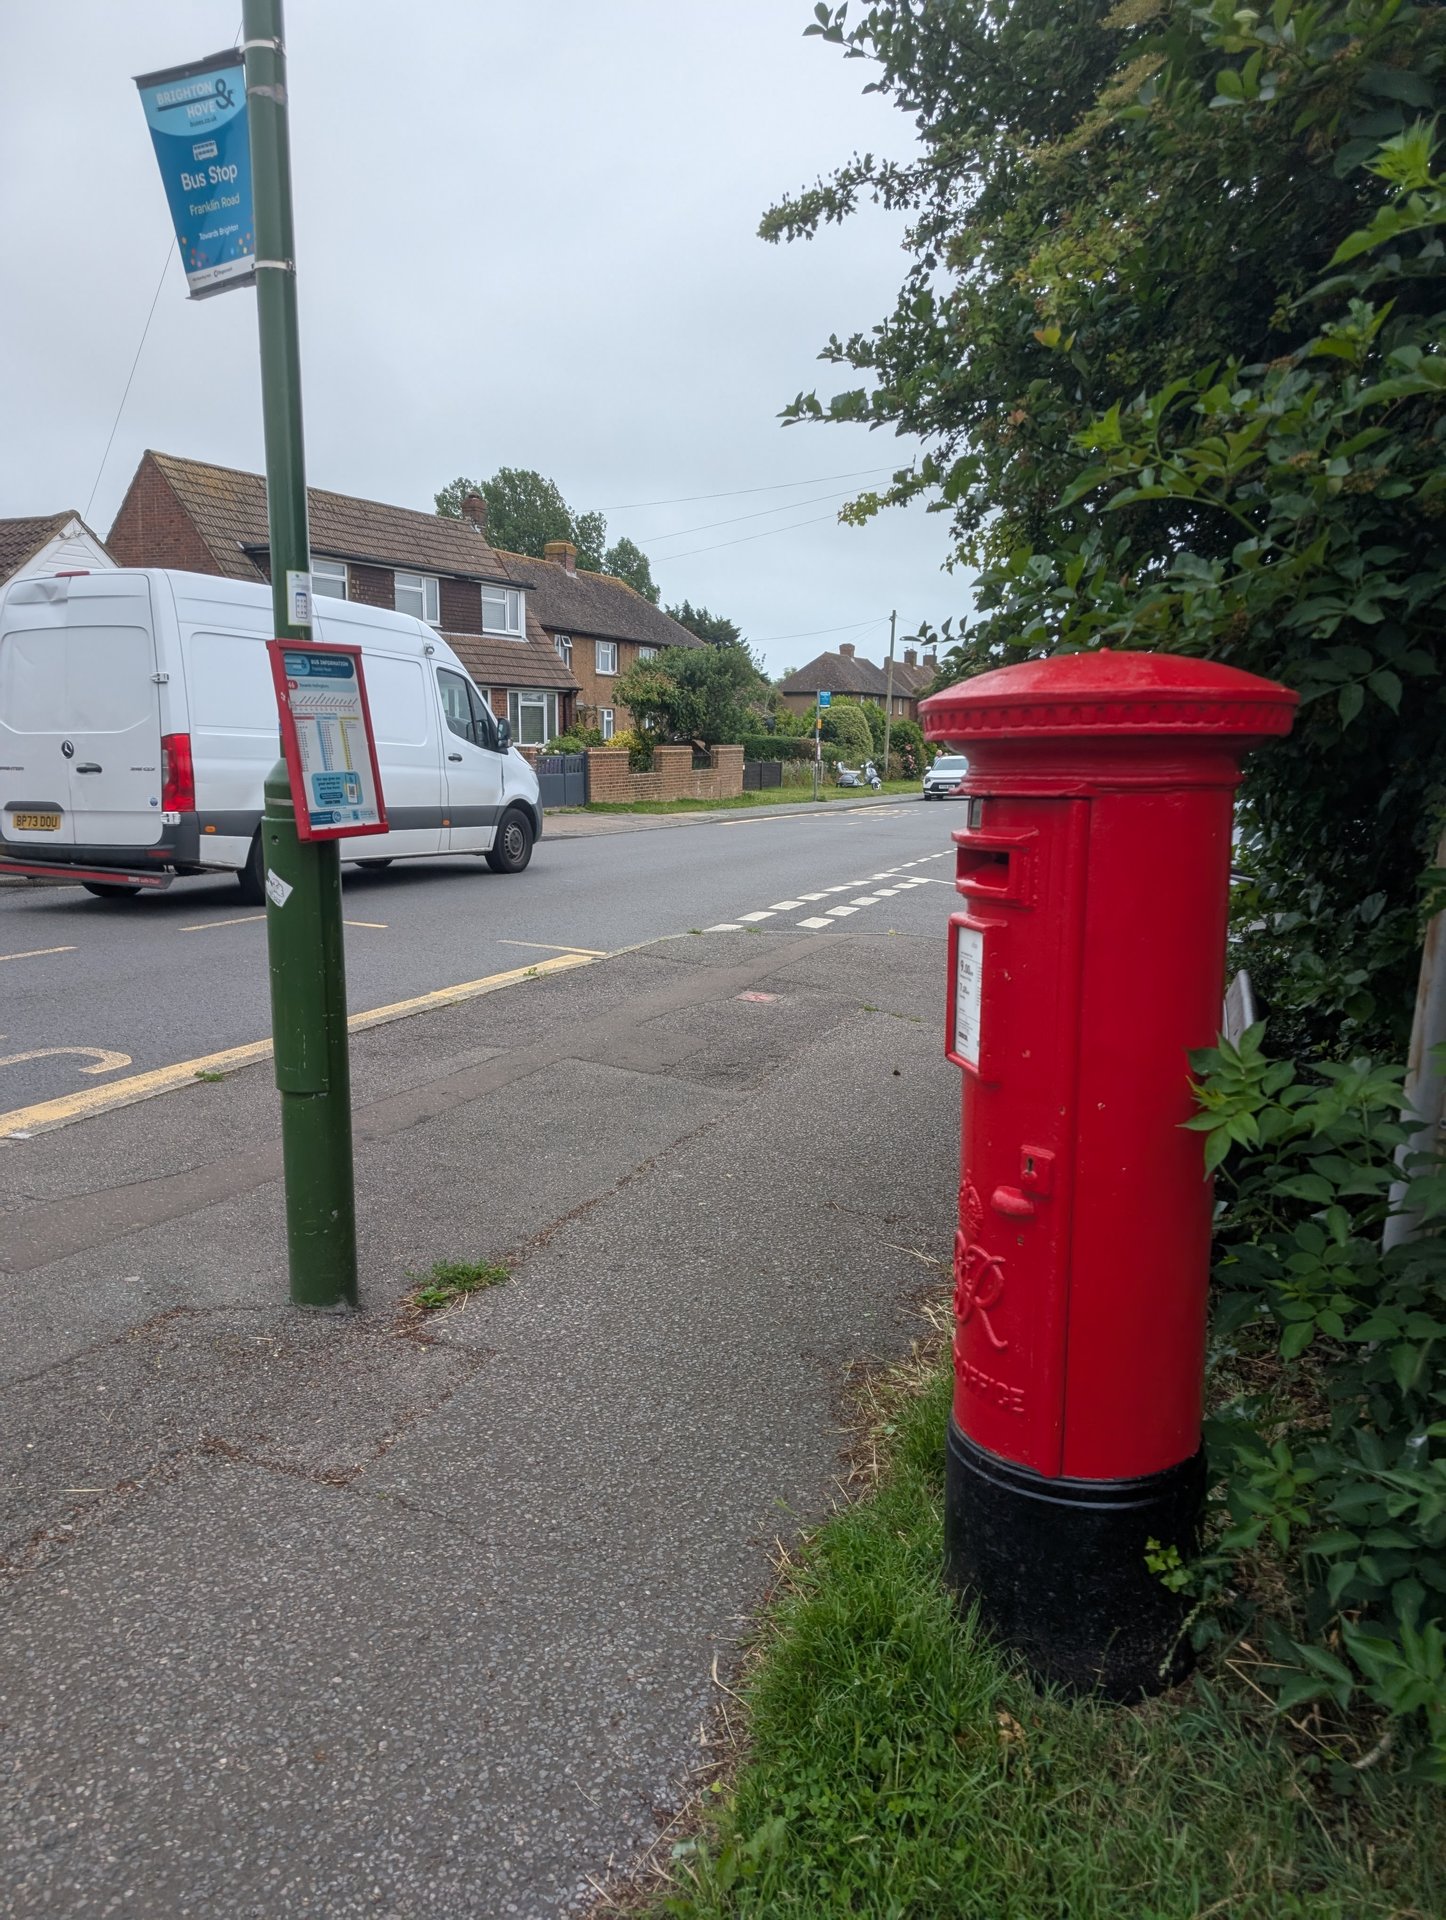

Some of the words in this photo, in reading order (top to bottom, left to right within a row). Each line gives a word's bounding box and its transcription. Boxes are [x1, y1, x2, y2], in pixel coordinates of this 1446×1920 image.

[156, 81, 213, 106] BRIGHTON
[186, 101, 217, 119] HOVE
[181, 172, 207, 191] Bus
[208, 164, 238, 183] Stop
[189, 199, 220, 216] Franklin
[221, 193, 240, 209] Road
[199, 228, 219, 241] Towards
[219, 224, 239, 236] Brighton
[16, 815, 38, 828] BP73
[40, 815, 58, 828] DOU
